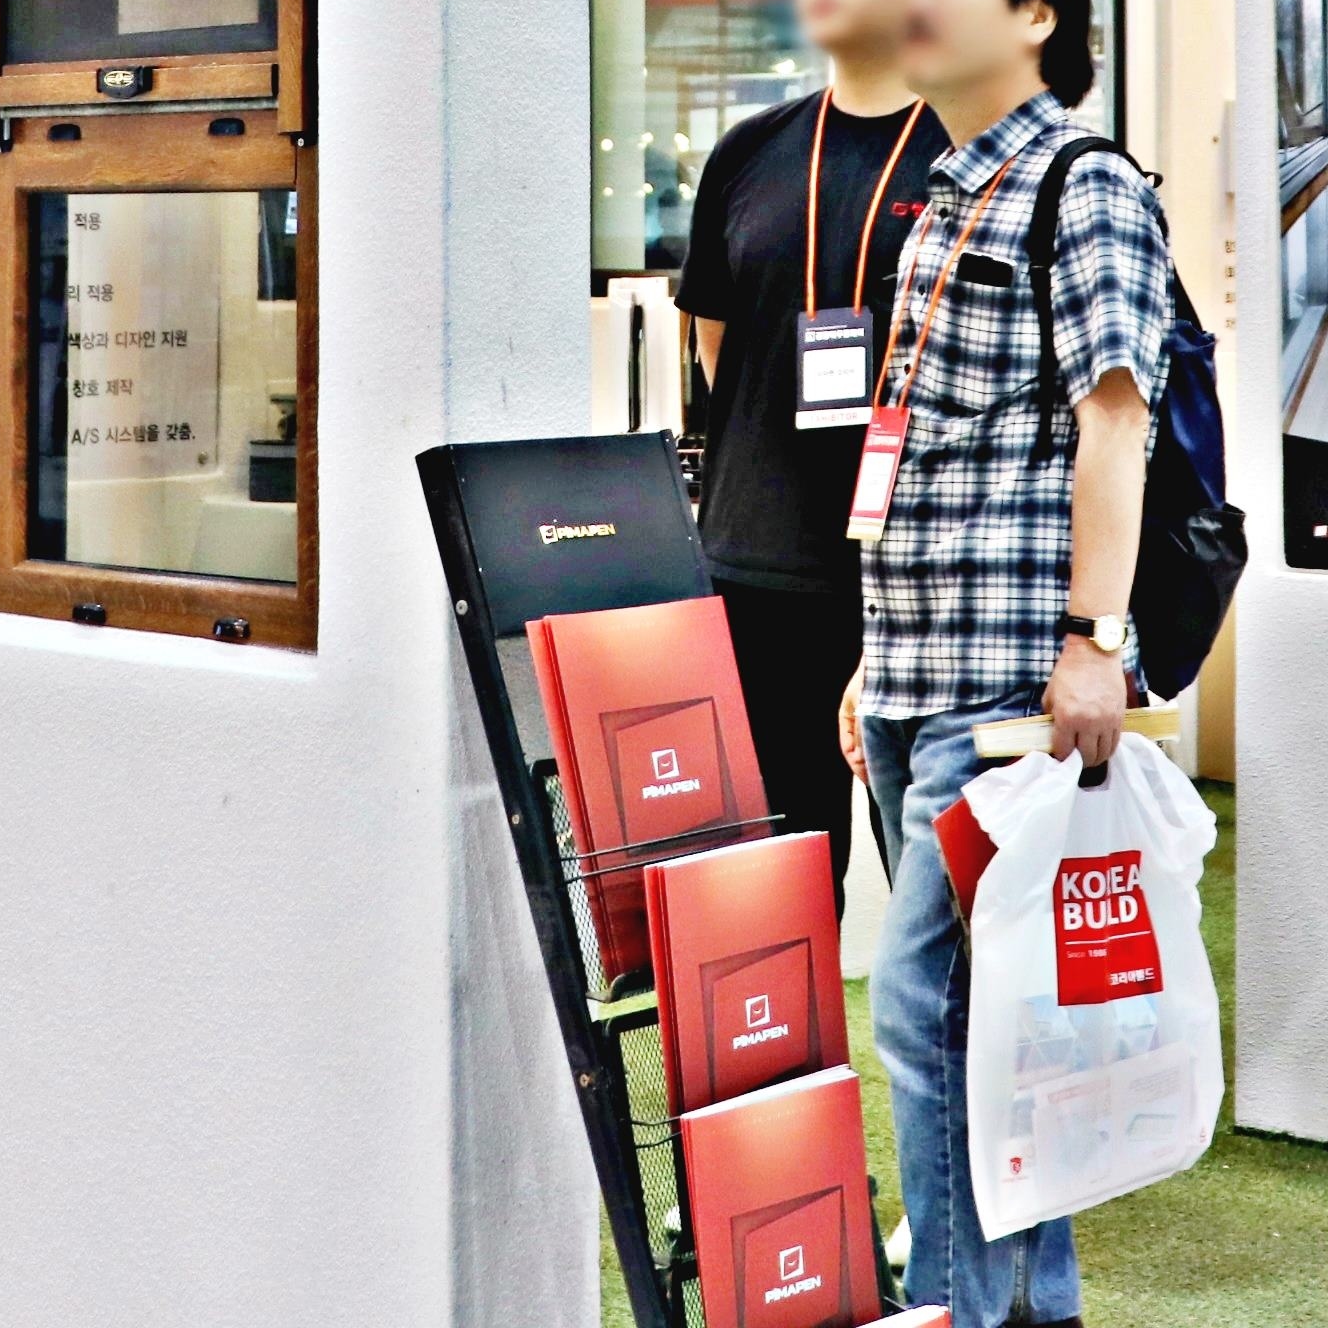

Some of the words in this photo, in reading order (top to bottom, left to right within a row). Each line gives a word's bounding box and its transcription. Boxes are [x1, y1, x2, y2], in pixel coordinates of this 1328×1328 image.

[115, 331, 156, 349] 디자인
[161, 329, 188, 348] 지원
[71, 426, 101, 446] A/S
